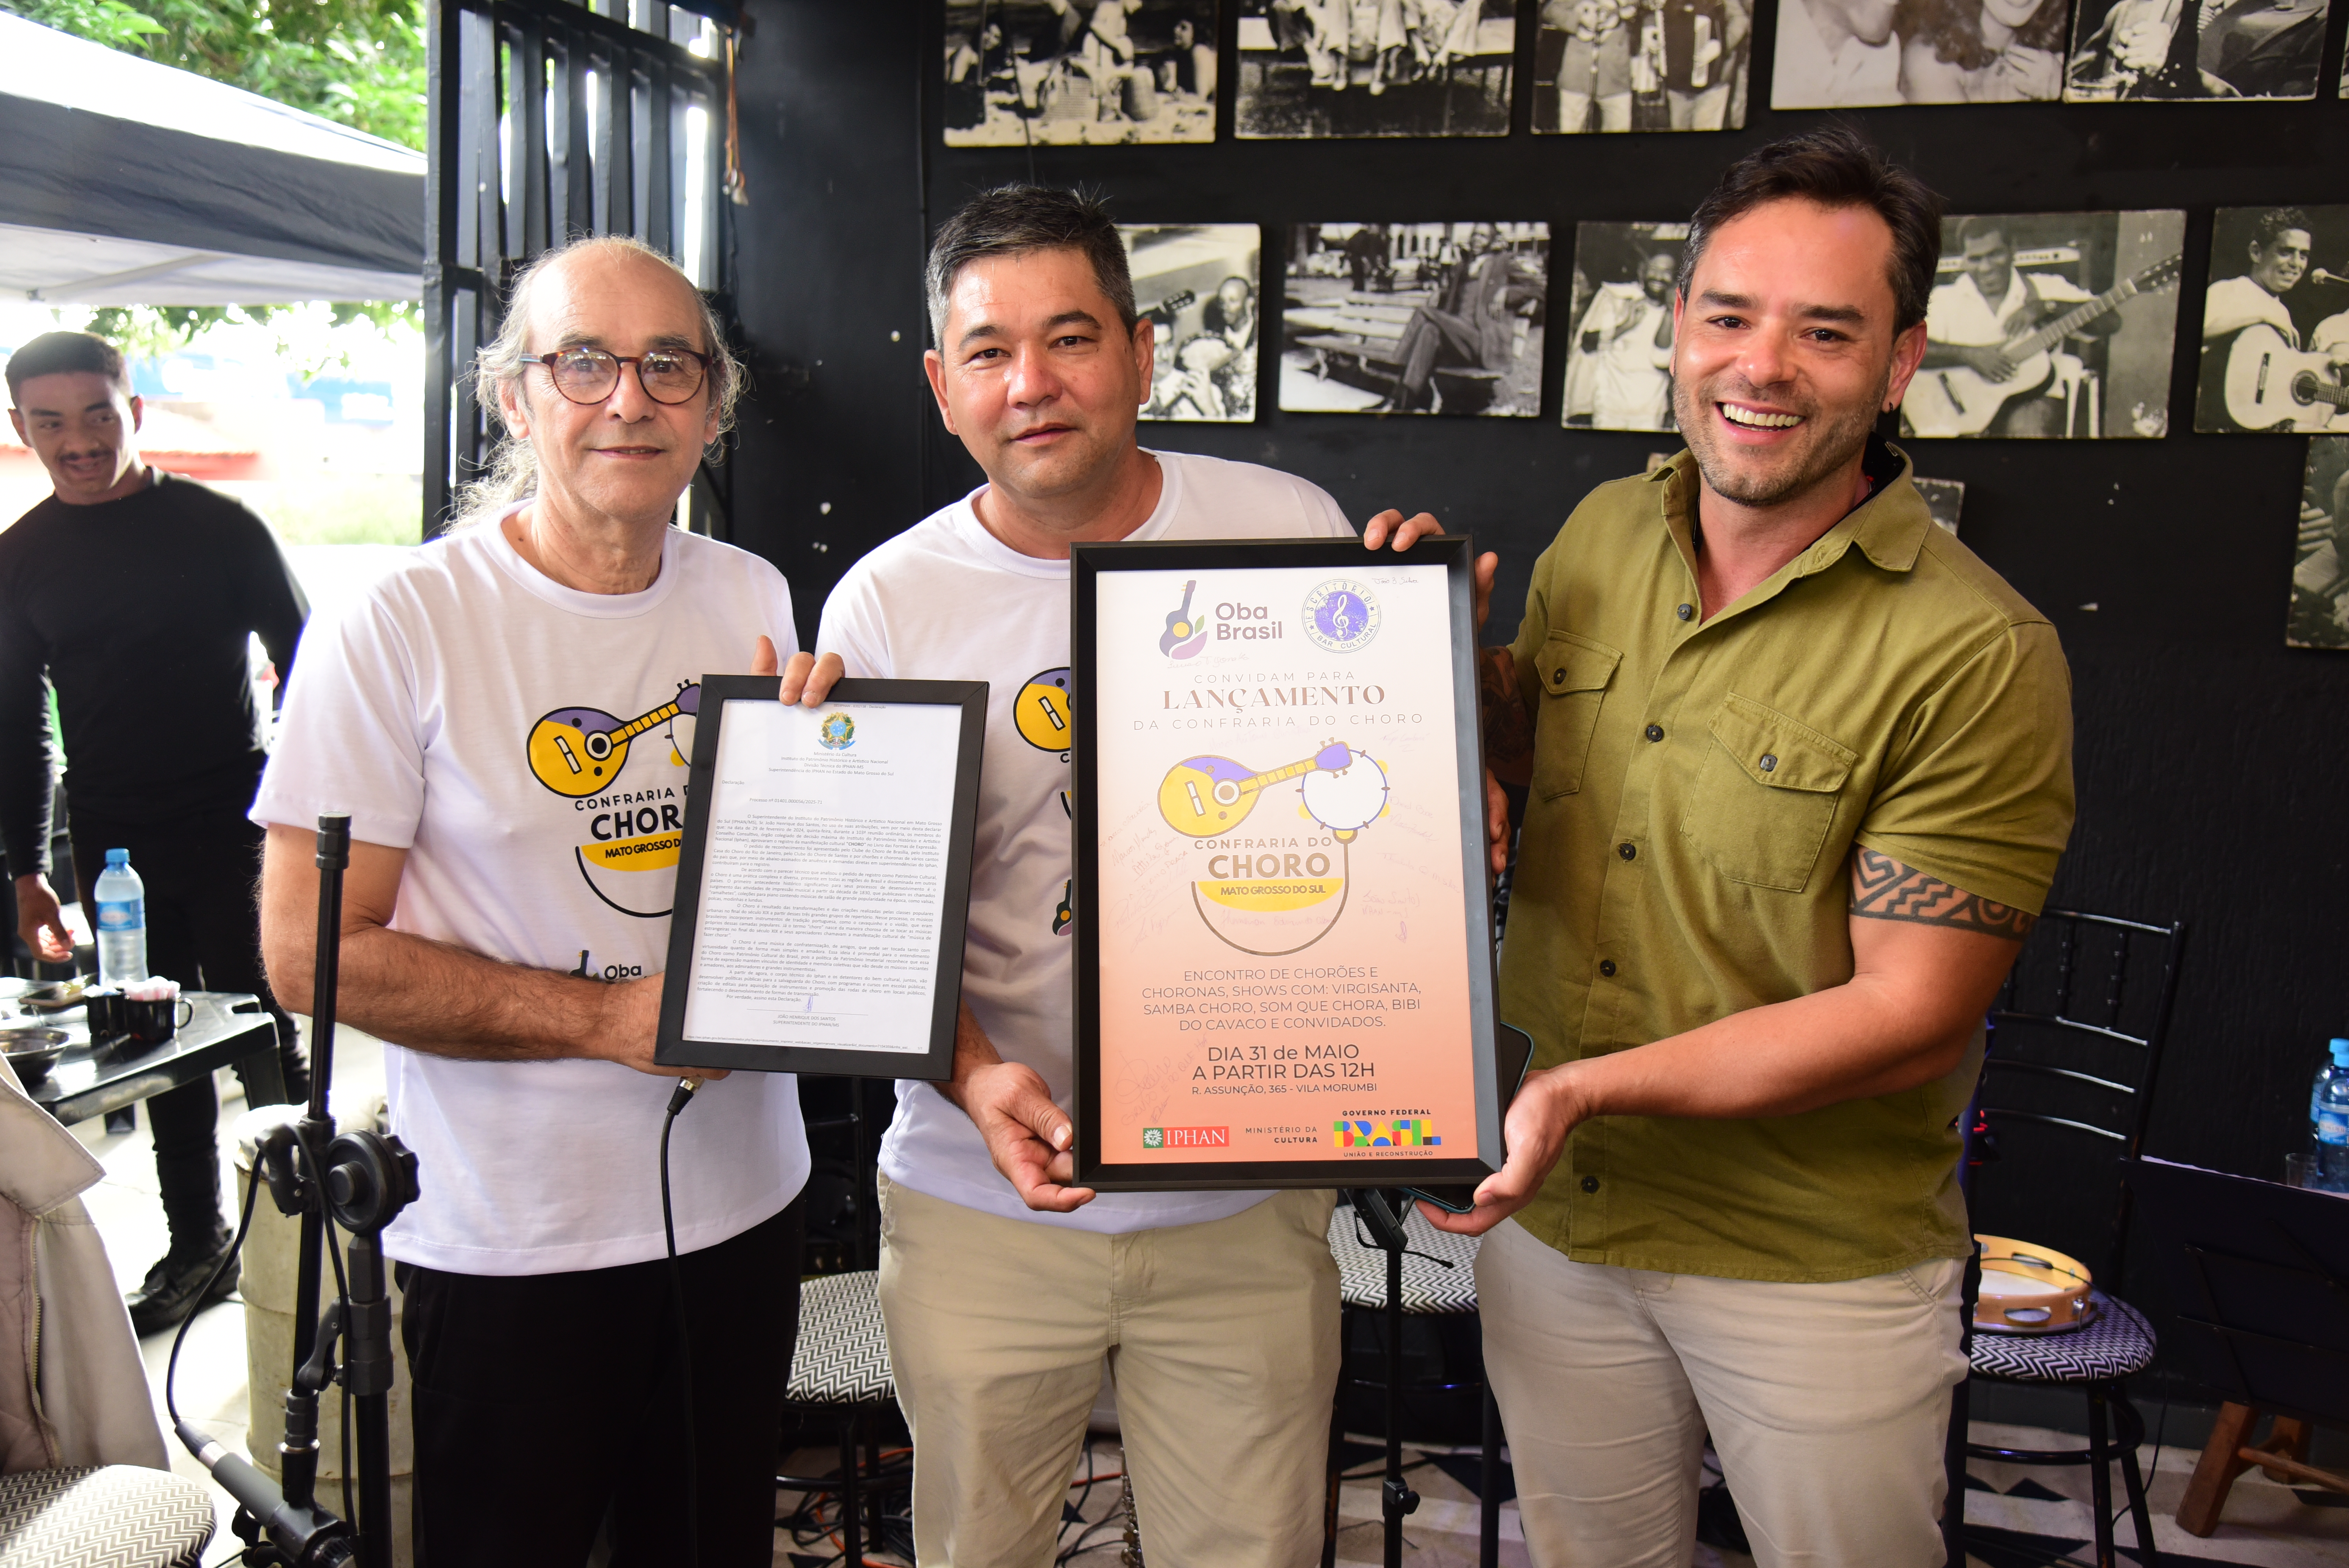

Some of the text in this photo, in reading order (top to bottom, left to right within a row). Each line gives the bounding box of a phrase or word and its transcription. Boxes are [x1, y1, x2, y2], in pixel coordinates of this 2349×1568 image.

[1306, 581, 1371, 619] ESCRITÓRIO
[1215, 603, 1267, 620] Oba
[1217, 621, 1282, 640] Brasil
[1317, 624, 1376, 649] BAR CULTURAL
[1194, 672, 1354, 683] CONVIDAM PARA
[1164, 685, 1384, 713] LANÇAMENTO
[1134, 714, 1422, 730] DA CONFRARIA DO CHORO
[575, 788, 675, 811] CONFRARIA
[591, 804, 683, 841] CHOR
[605, 838, 681, 859] MATO GROSSO D
[1194, 837, 1331, 849] CONFRARIA DO
[1208, 853, 1330, 879] CHORO
[1221, 885, 1326, 895] MATO GROSSO DO SUL
[604, 964, 642, 980] Oba
[1185, 965, 1378, 981] ENCONTRO DE CHORÕES E
[1142, 983, 1421, 998] CHORONAS, SHOWS COM: VIRGISANTA,
[1144, 999, 1419, 1015] SAMBA CHORO, SOM QUE CHORA, BIBI
[1180, 1016, 1385, 1030] DO CAVACO E CONVIDADOS.
[1209, 1044, 1359, 1061] DIA 31 de MAIO
[1192, 1063, 1374, 1080] A PARTIR DAS 12H
[1204, 1084, 1266, 1096] ASSUNÇÃO,
[1324, 1083, 1376, 1092] MORUMBI
[1167, 1129, 1225, 1145] IPHAN
[1334, 1119, 1441, 1147] BRASIL
